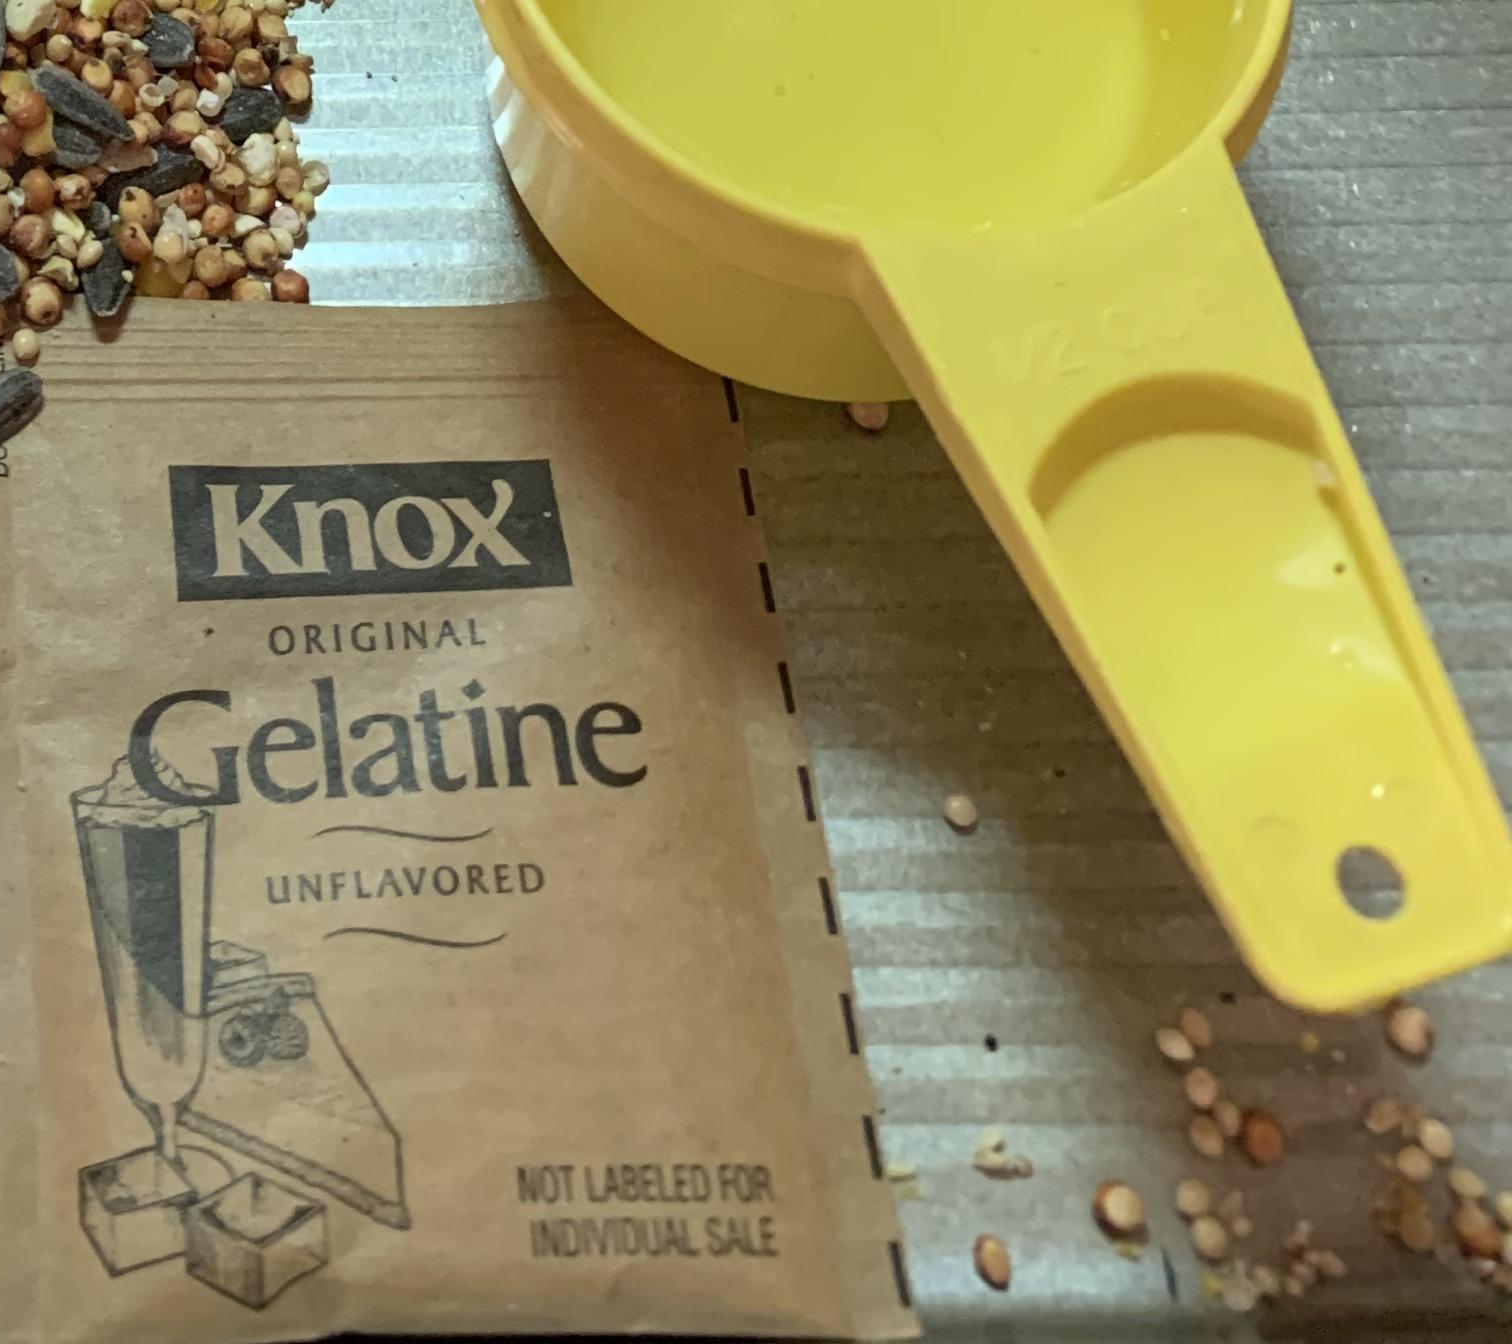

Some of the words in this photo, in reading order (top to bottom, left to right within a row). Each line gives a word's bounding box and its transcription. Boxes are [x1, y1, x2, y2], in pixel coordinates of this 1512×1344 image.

[205, 478, 531, 578] Knox
[268, 618, 486, 656] ORIGINAL
[129, 676, 648, 807] Gelatine
[267, 863, 545, 905] UNFLAVORED
[516, 1164, 574, 1204] NOT
[584, 1163, 711, 1203] LABELED
[717, 1163, 774, 1202] FOR
[530, 1217, 701, 1257] INDIVIDUAL
[705, 1215, 778, 1257] SALE
